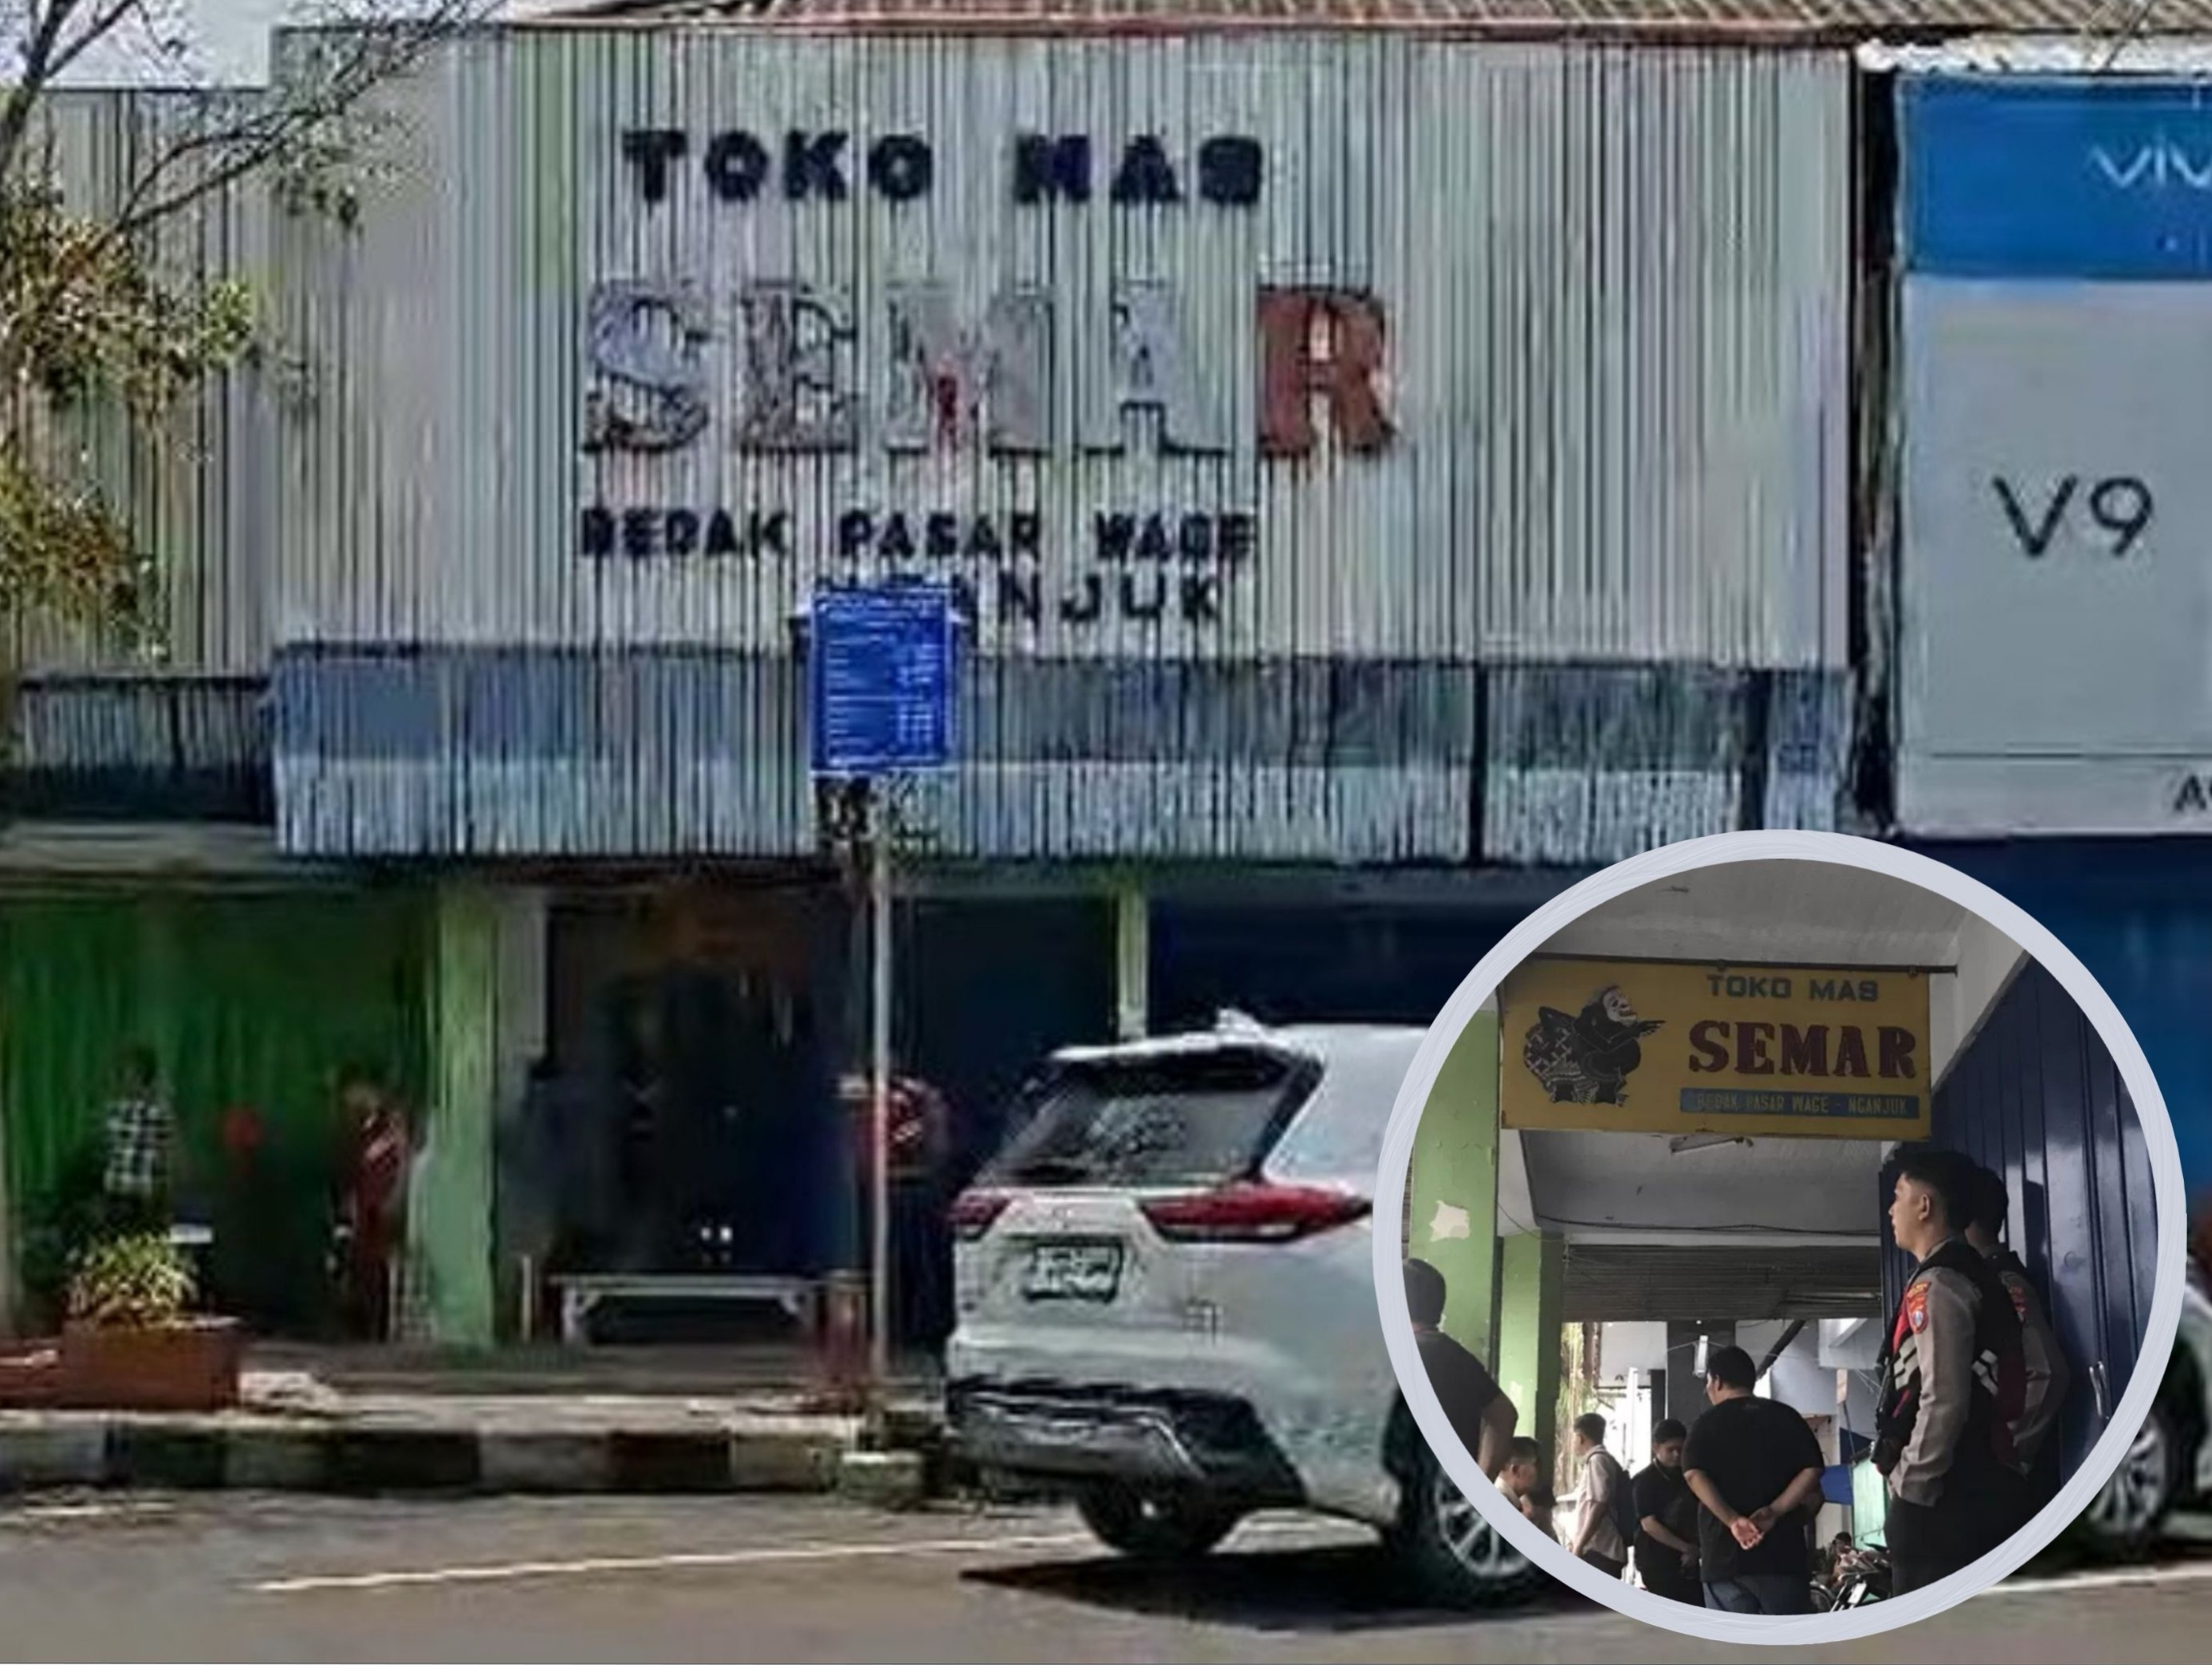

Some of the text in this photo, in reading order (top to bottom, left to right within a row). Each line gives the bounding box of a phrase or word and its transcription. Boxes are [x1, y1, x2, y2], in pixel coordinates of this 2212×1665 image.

[622, 129, 1263, 205] TOKO MAS
[839, 510, 1040, 559] PASAR
[1994, 474, 2154, 559] V9
[1706, 973, 1878, 1001] TOKO MAS
[1688, 1020, 1917, 1078] SEMAR
[1791, 1095, 1829, 1114] WAGE
